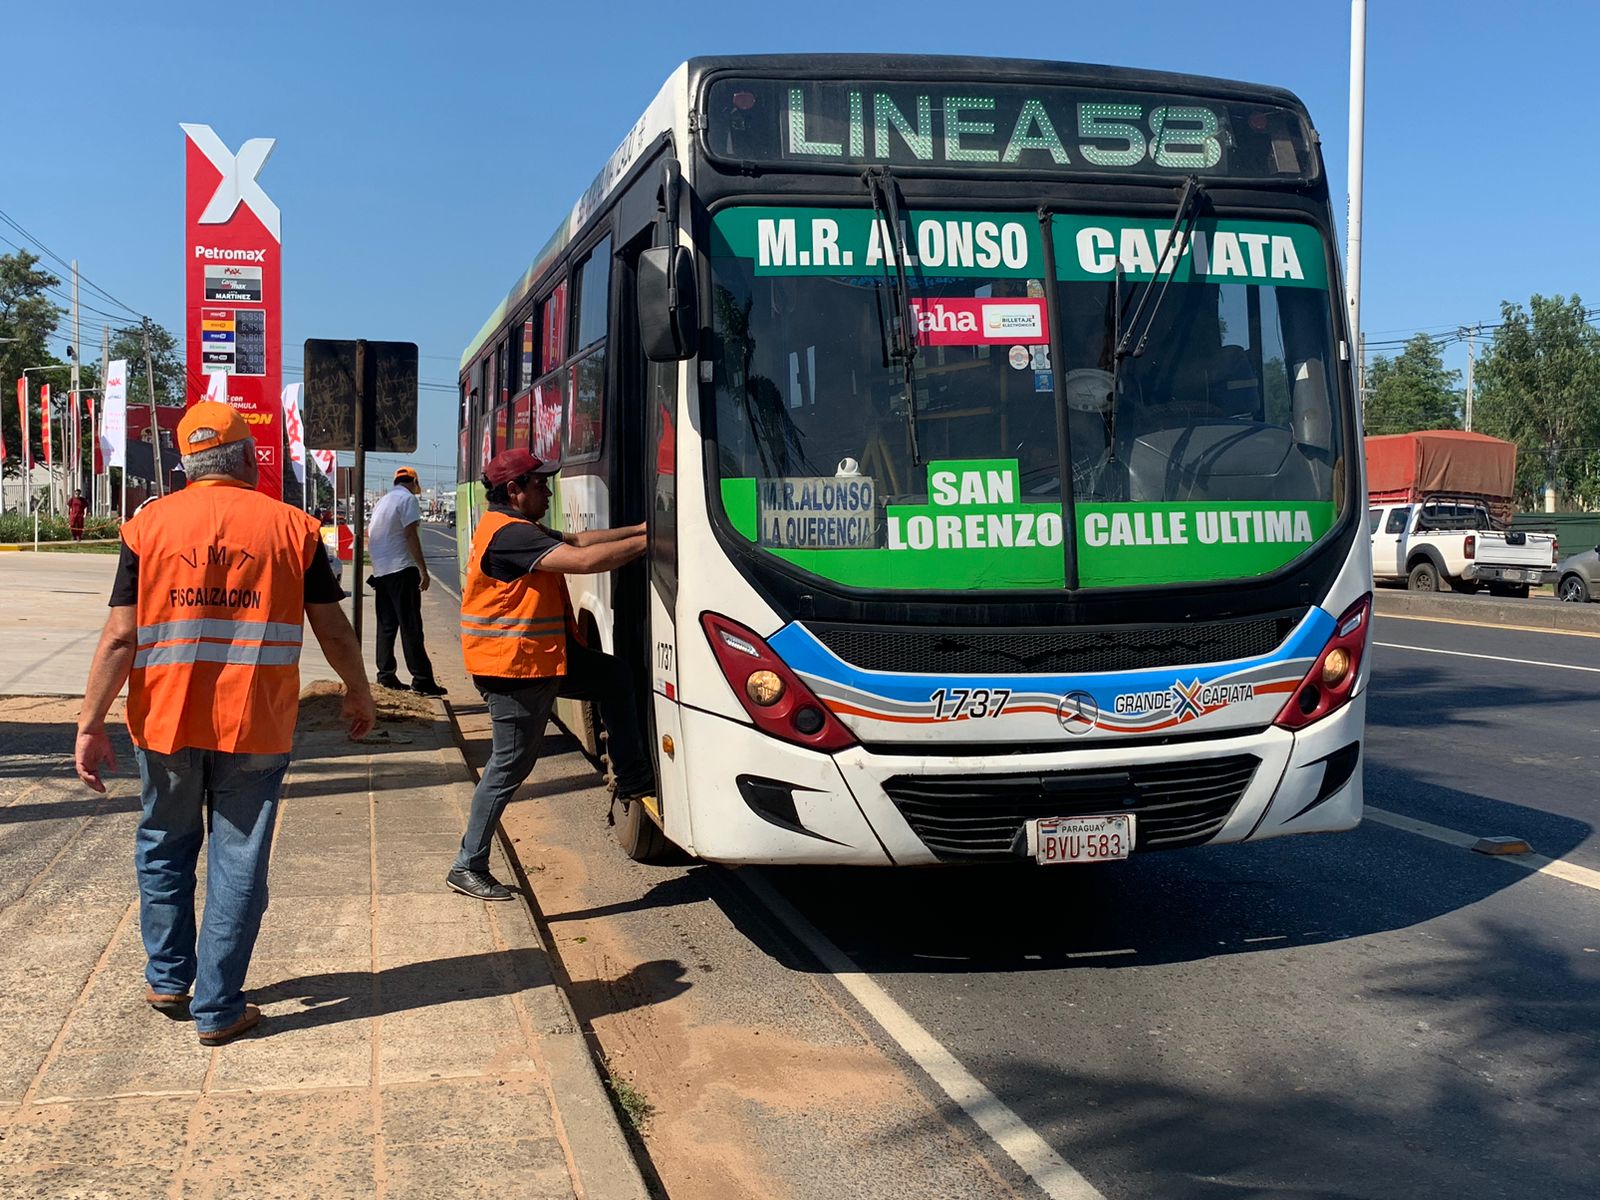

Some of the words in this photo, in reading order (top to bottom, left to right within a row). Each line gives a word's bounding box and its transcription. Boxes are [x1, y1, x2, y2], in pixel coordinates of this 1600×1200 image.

[865, 219, 1029, 270] ALONSO
[1076, 227, 1305, 280] CAPIATA
[932, 470, 1014, 505] SAN
[786, 516, 872, 546] QUERENCIA
[887, 511, 1063, 550] LORENZO
[1084, 512, 1189, 547] CALLE
[1195, 510, 1313, 545] ULTIMA
[656, 641, 673, 671] 1737
[930, 688, 1012, 719] 1737
[1114, 692, 1172, 713] GRANDE
[1202, 684, 1255, 706] CAPIATA
[1061, 824, 1105, 833] PARAGUAY
[1087, 834, 1121, 858] 583
